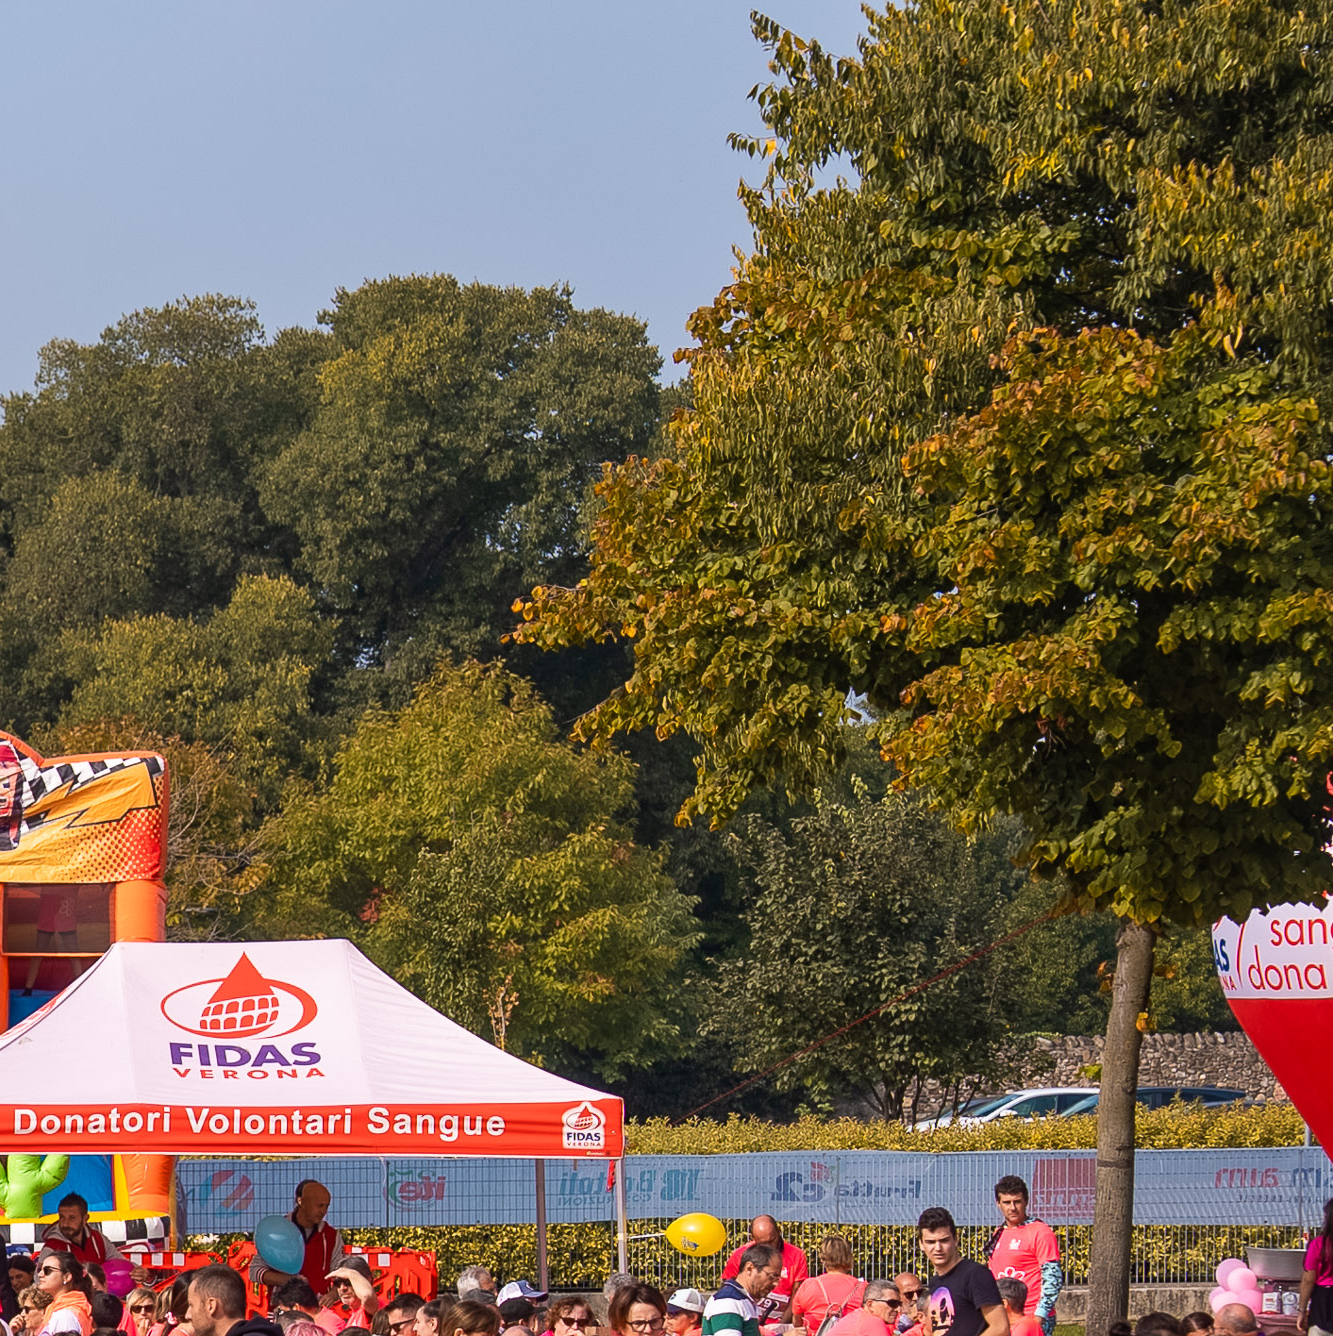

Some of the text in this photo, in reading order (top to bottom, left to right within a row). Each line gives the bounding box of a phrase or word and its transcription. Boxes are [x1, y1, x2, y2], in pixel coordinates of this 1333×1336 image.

[1248, 945, 1327, 991] dona
[169, 1042, 322, 1067] FIDAS
[173, 1068, 325, 1079] VERONA
[14, 1106, 506, 1142] Donatori Volontari Sangue
[566, 1132, 601, 1141] FIDAS
